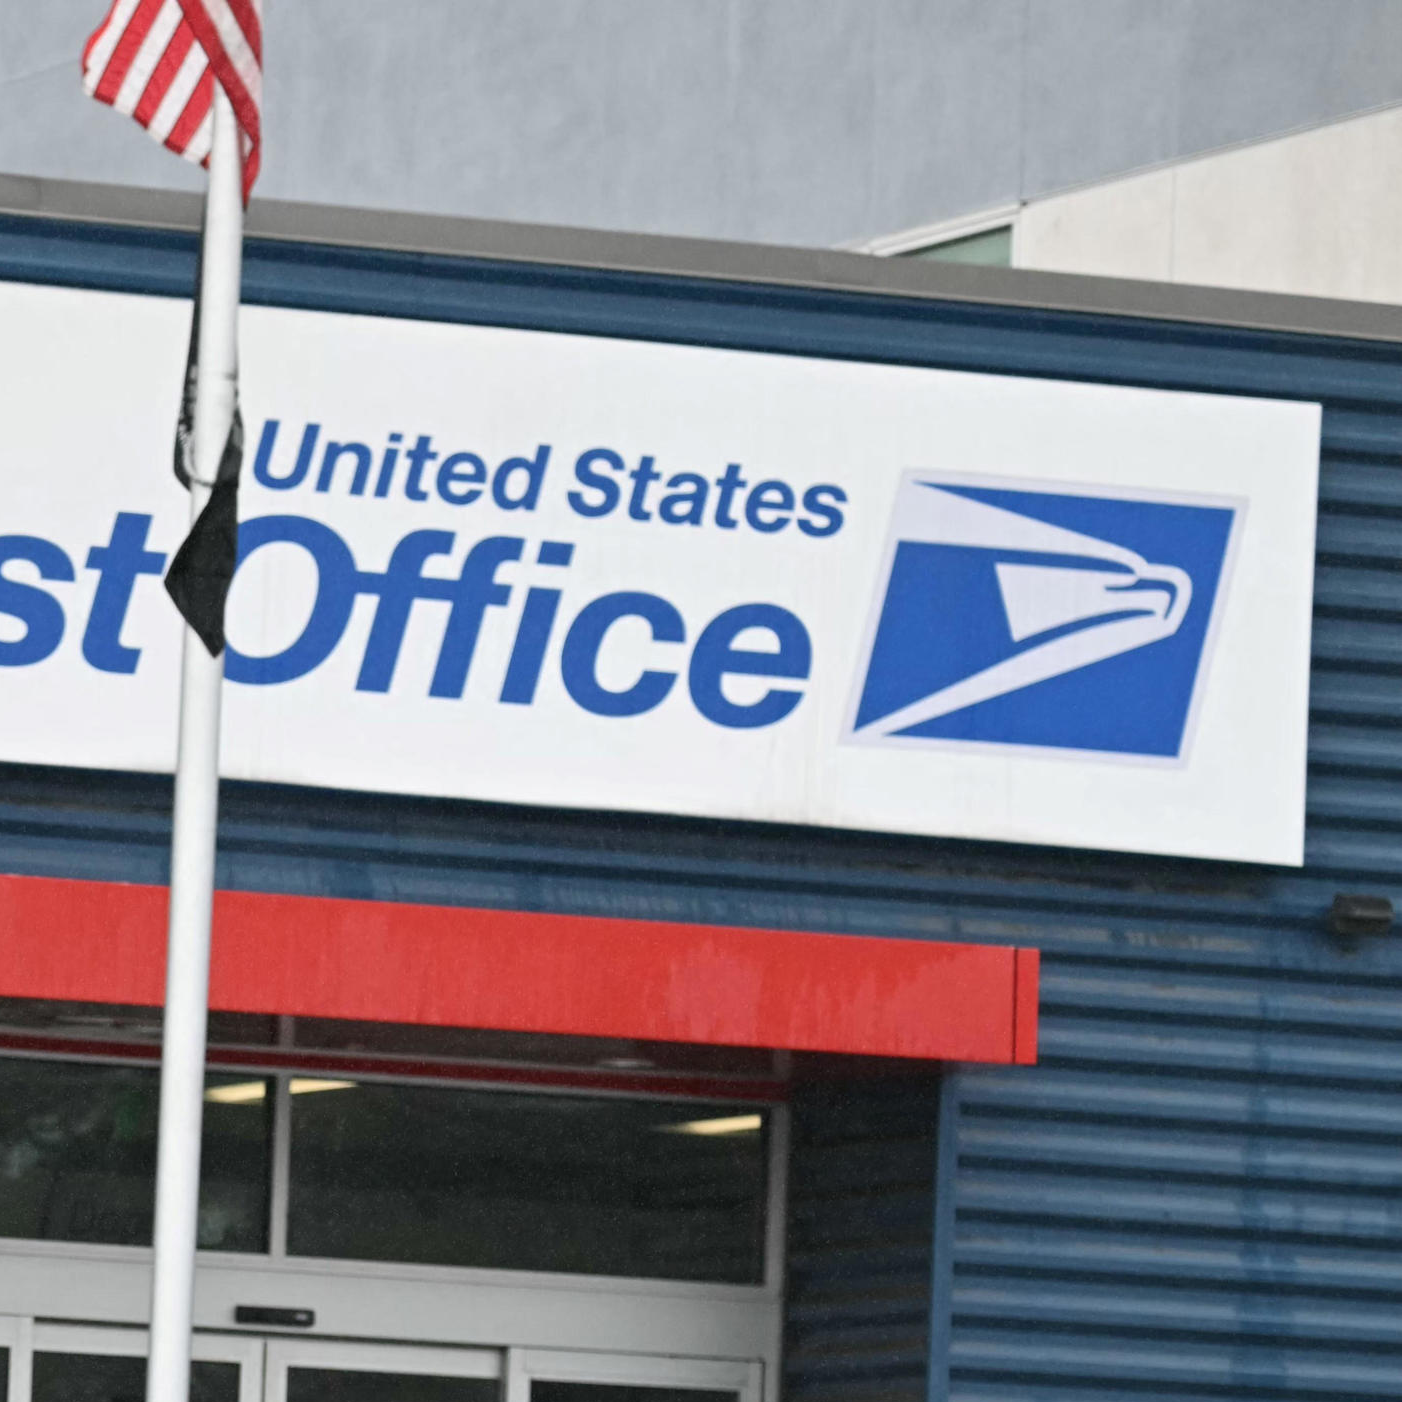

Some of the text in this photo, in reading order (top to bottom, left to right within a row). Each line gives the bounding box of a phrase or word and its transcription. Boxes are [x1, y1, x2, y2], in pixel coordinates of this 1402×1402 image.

[253, 420, 848, 539] United States
[222, 514, 813, 730] Office
